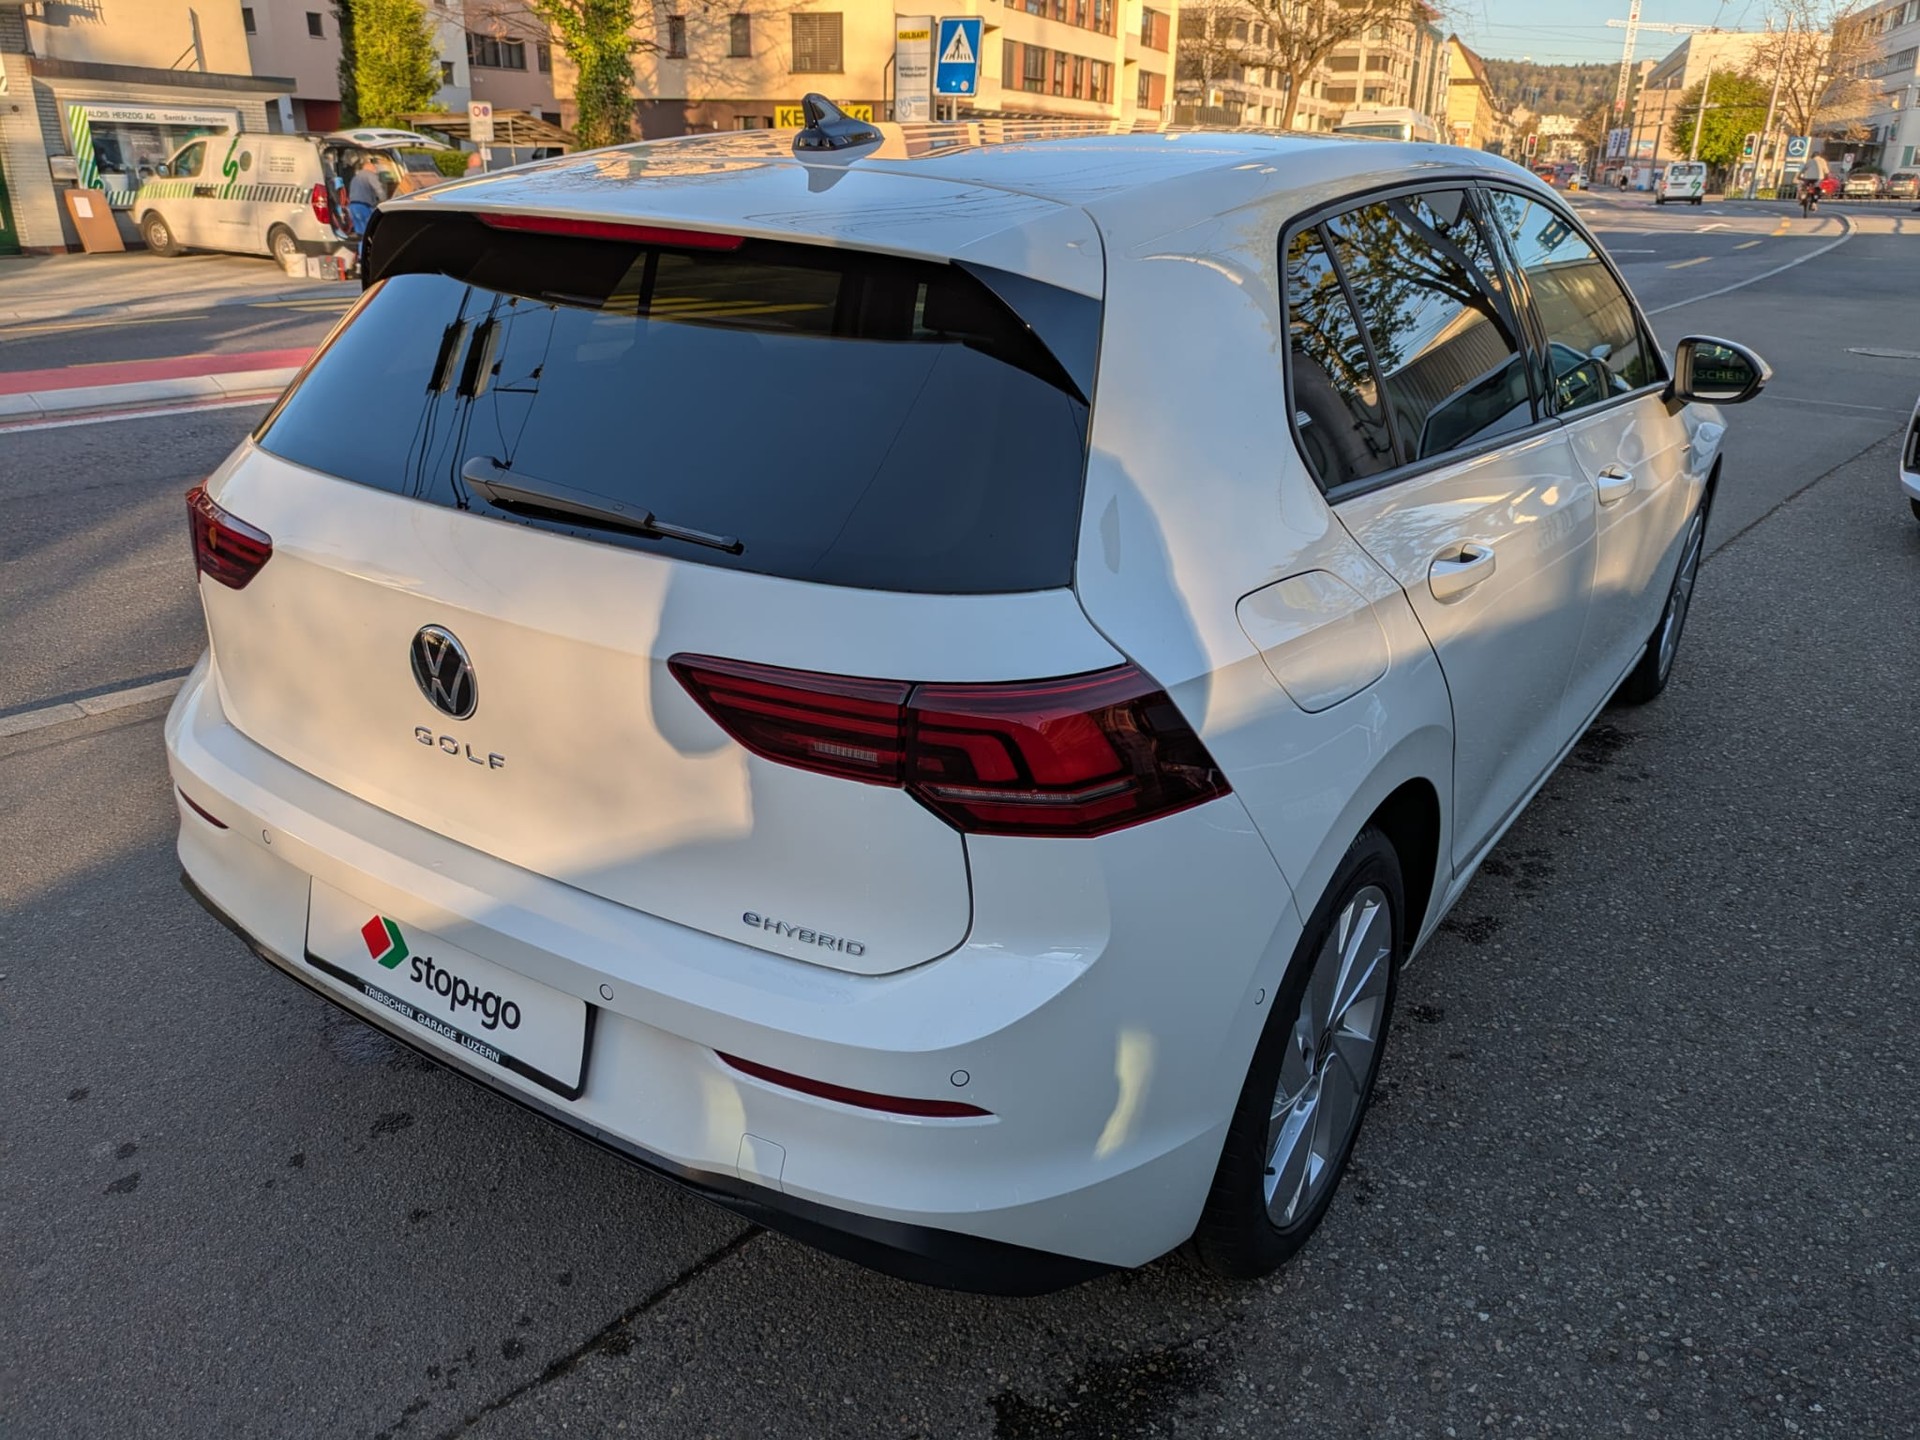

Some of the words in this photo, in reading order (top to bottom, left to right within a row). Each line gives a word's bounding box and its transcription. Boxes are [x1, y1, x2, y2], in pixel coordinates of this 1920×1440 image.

[112, 111, 143, 120] HERZOG
[145, 112, 156, 120] AG
[414, 725, 505, 770] GOLF
[742, 911, 866, 957] eHYBRID
[409, 955, 521, 1031] stop+go
[363, 985, 413, 1018] TRIBSCHEN
[417, 1013, 457, 1041] GARAGE
[460, 1035, 501, 1063] LUZERN
